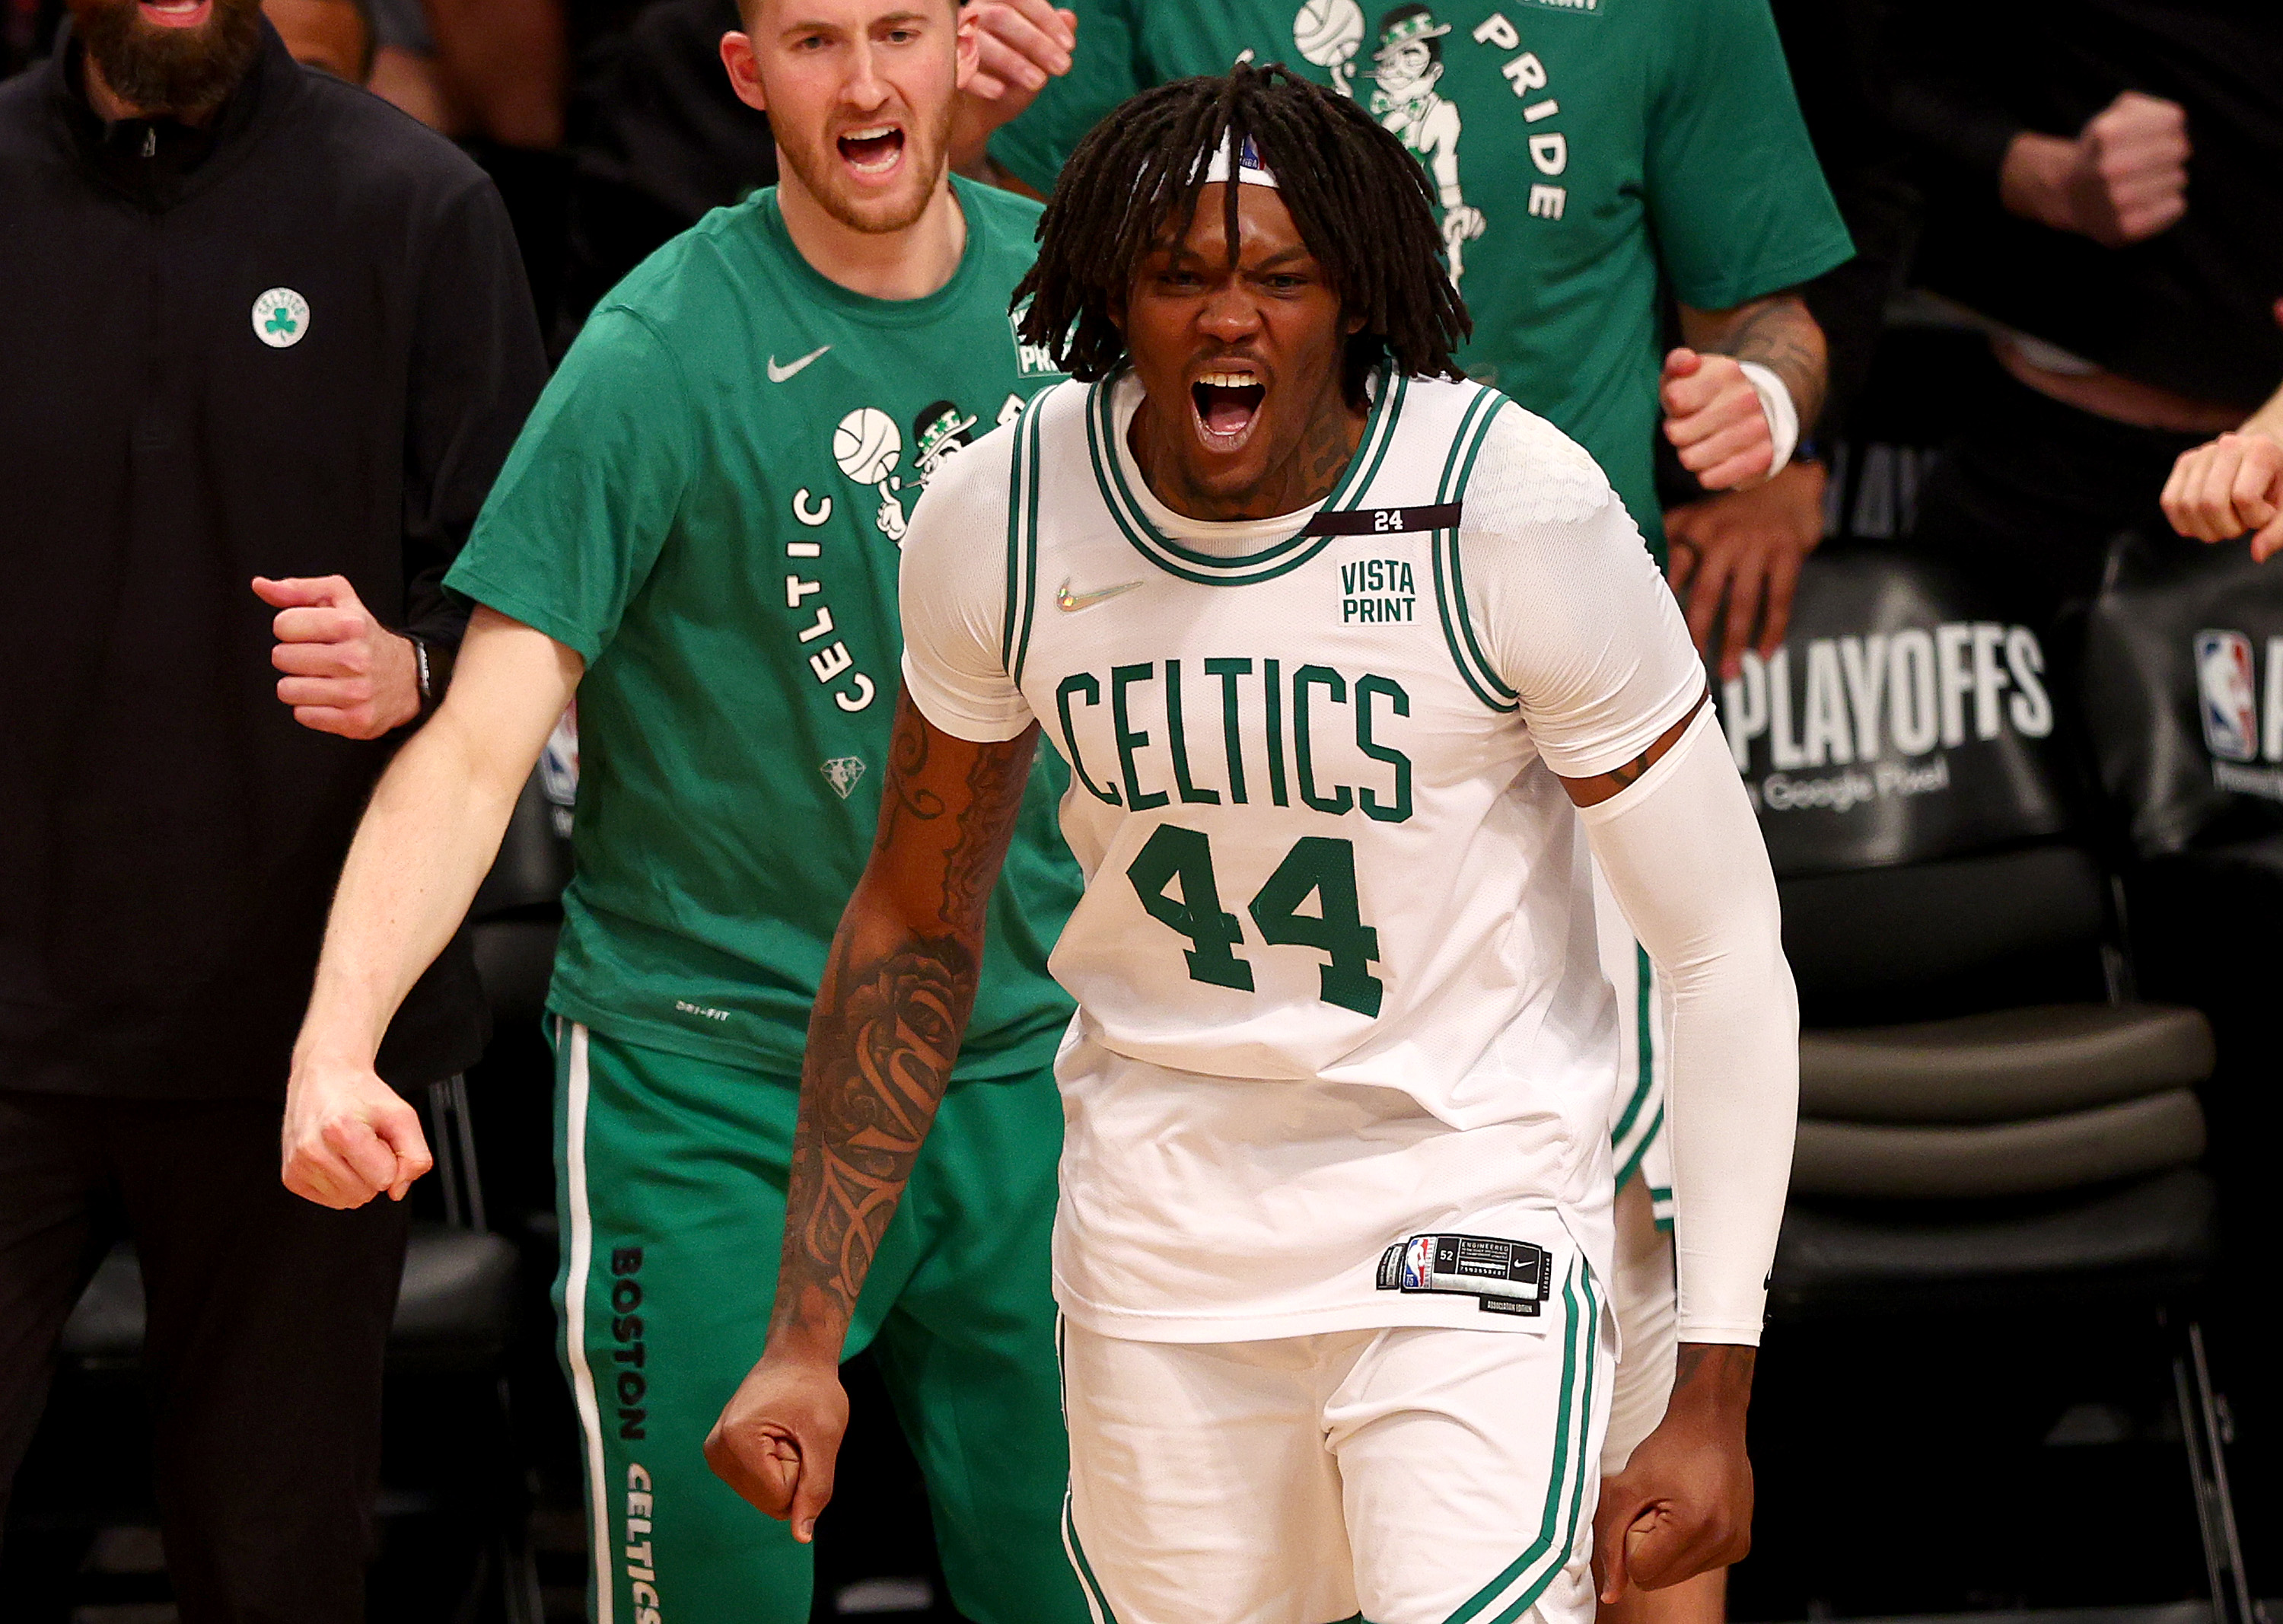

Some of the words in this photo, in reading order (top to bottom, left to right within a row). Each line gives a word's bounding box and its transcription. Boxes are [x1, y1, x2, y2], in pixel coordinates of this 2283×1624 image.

[1472, 11, 1568, 221] PRIDE
[257, 291, 306, 316] CELTICS
[1374, 510, 1403, 531] 24
[786, 487, 876, 712] CELTIC
[1341, 559, 1415, 595] VISTA
[1343, 597, 1416, 623] PRINT
[1056, 658, 1413, 823] CELTICS
[1721, 621, 2054, 775] PLAYOFFS
[1126, 823, 1383, 1020] 44
[1440, 1250, 1454, 1262] 52
[1461, 1241, 1508, 1252] ENGINEERED
[611, 1247, 646, 1441] BOSTON
